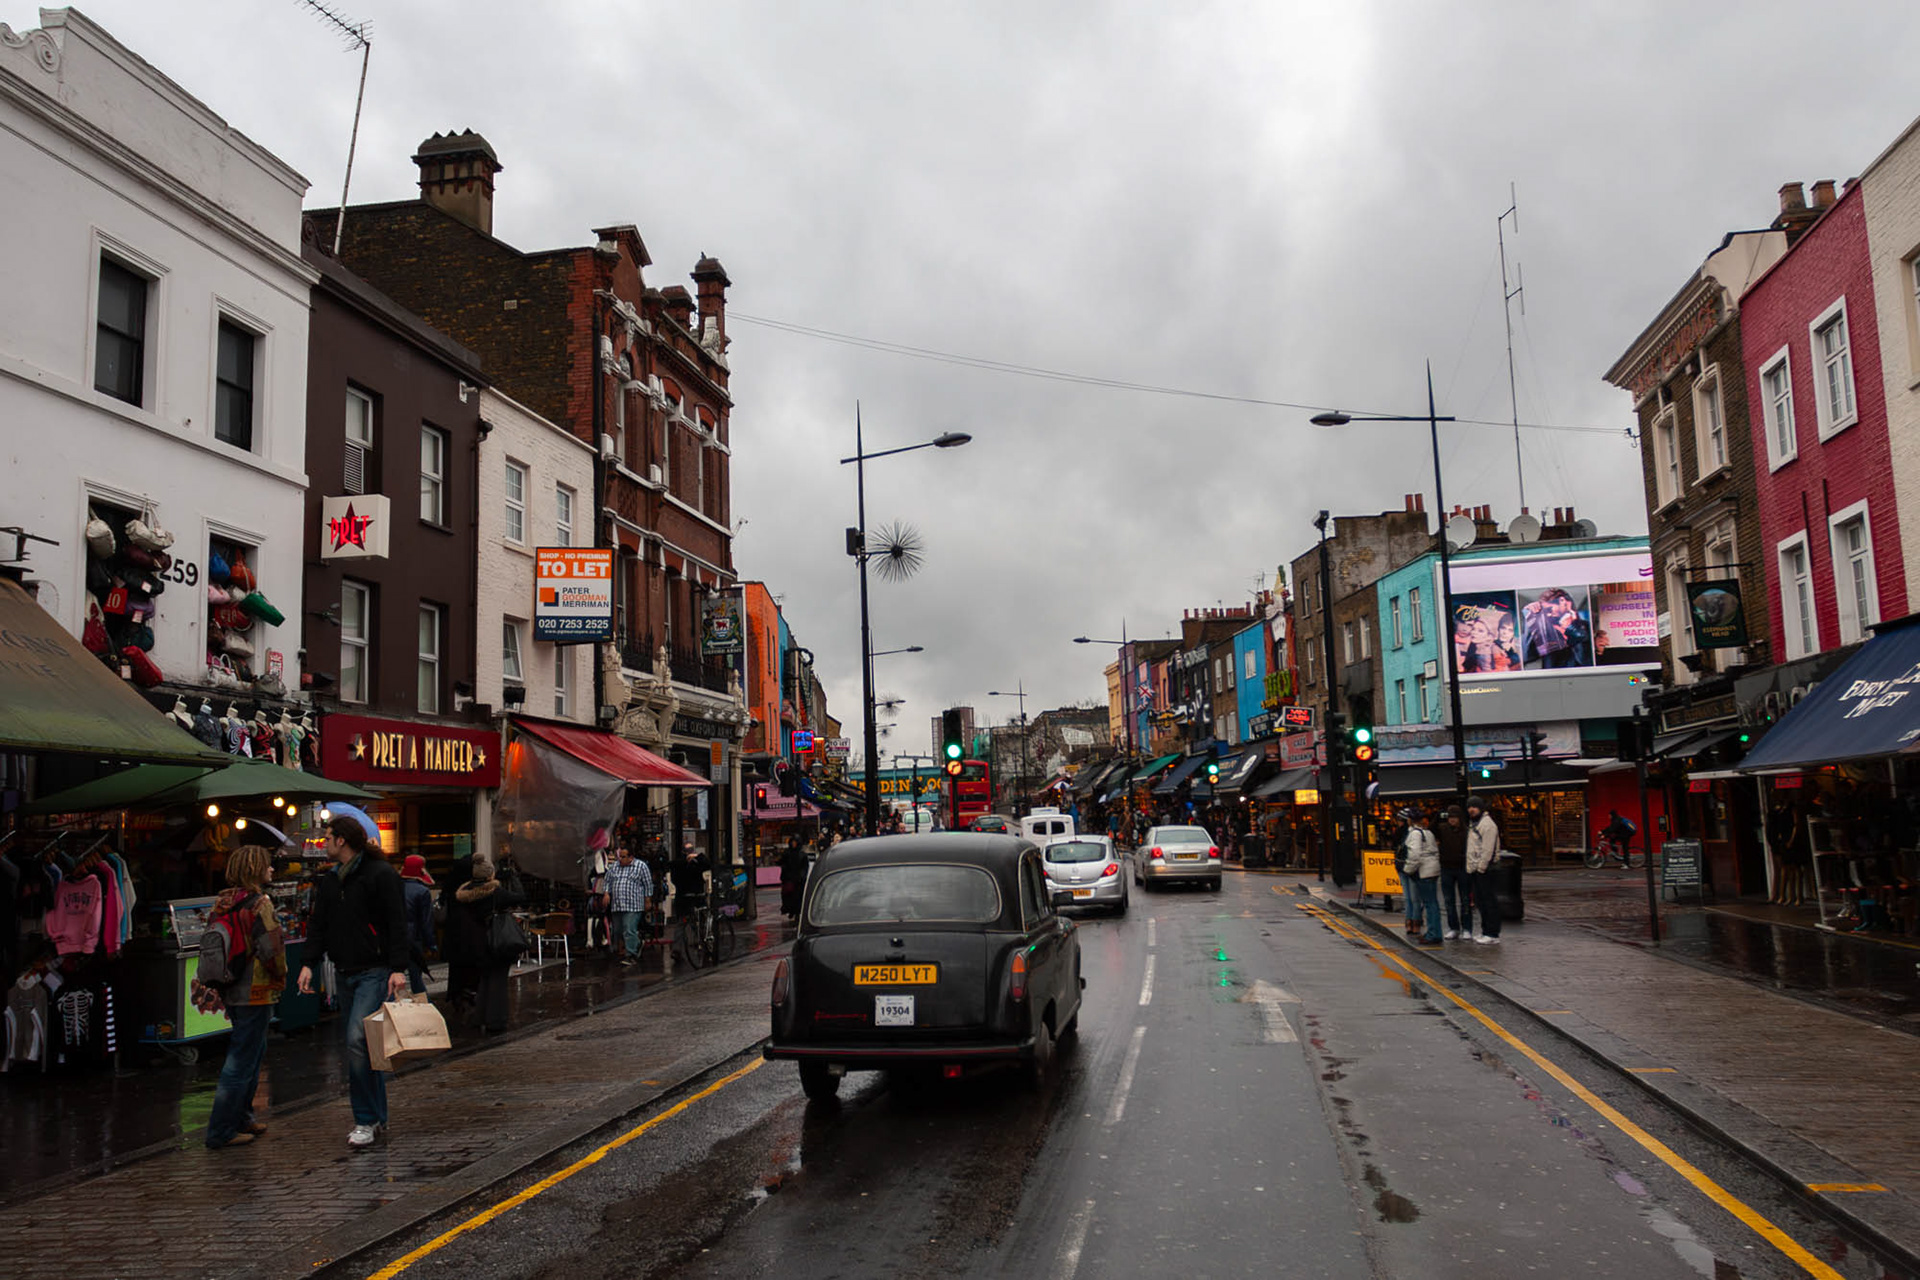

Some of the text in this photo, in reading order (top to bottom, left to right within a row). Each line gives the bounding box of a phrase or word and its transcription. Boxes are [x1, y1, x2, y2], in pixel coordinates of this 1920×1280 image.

[330, 515, 370, 545] PRET
[540, 552, 610, 560] SHOP NO PREMIUM
[539, 561, 609, 577] TO LET
[562, 587, 590, 595] PATER
[1625, 591, 1652, 600] LOSE
[562, 600, 609, 608] MERRIMAN
[1601, 602, 1653, 612] YOURSELF
[1642, 610, 1654, 618] IN
[538, 619, 609, 629] 020 7253 2525
[1610, 620, 1655, 628] SMOOTH
[1622, 629, 1656, 637] RADIO
[690, 720, 716, 738] OXFORD
[372, 731, 474, 773] PRET A MANGER
[859, 967, 931, 982] M250 LYT
[881, 1006, 910, 1016] 19304
